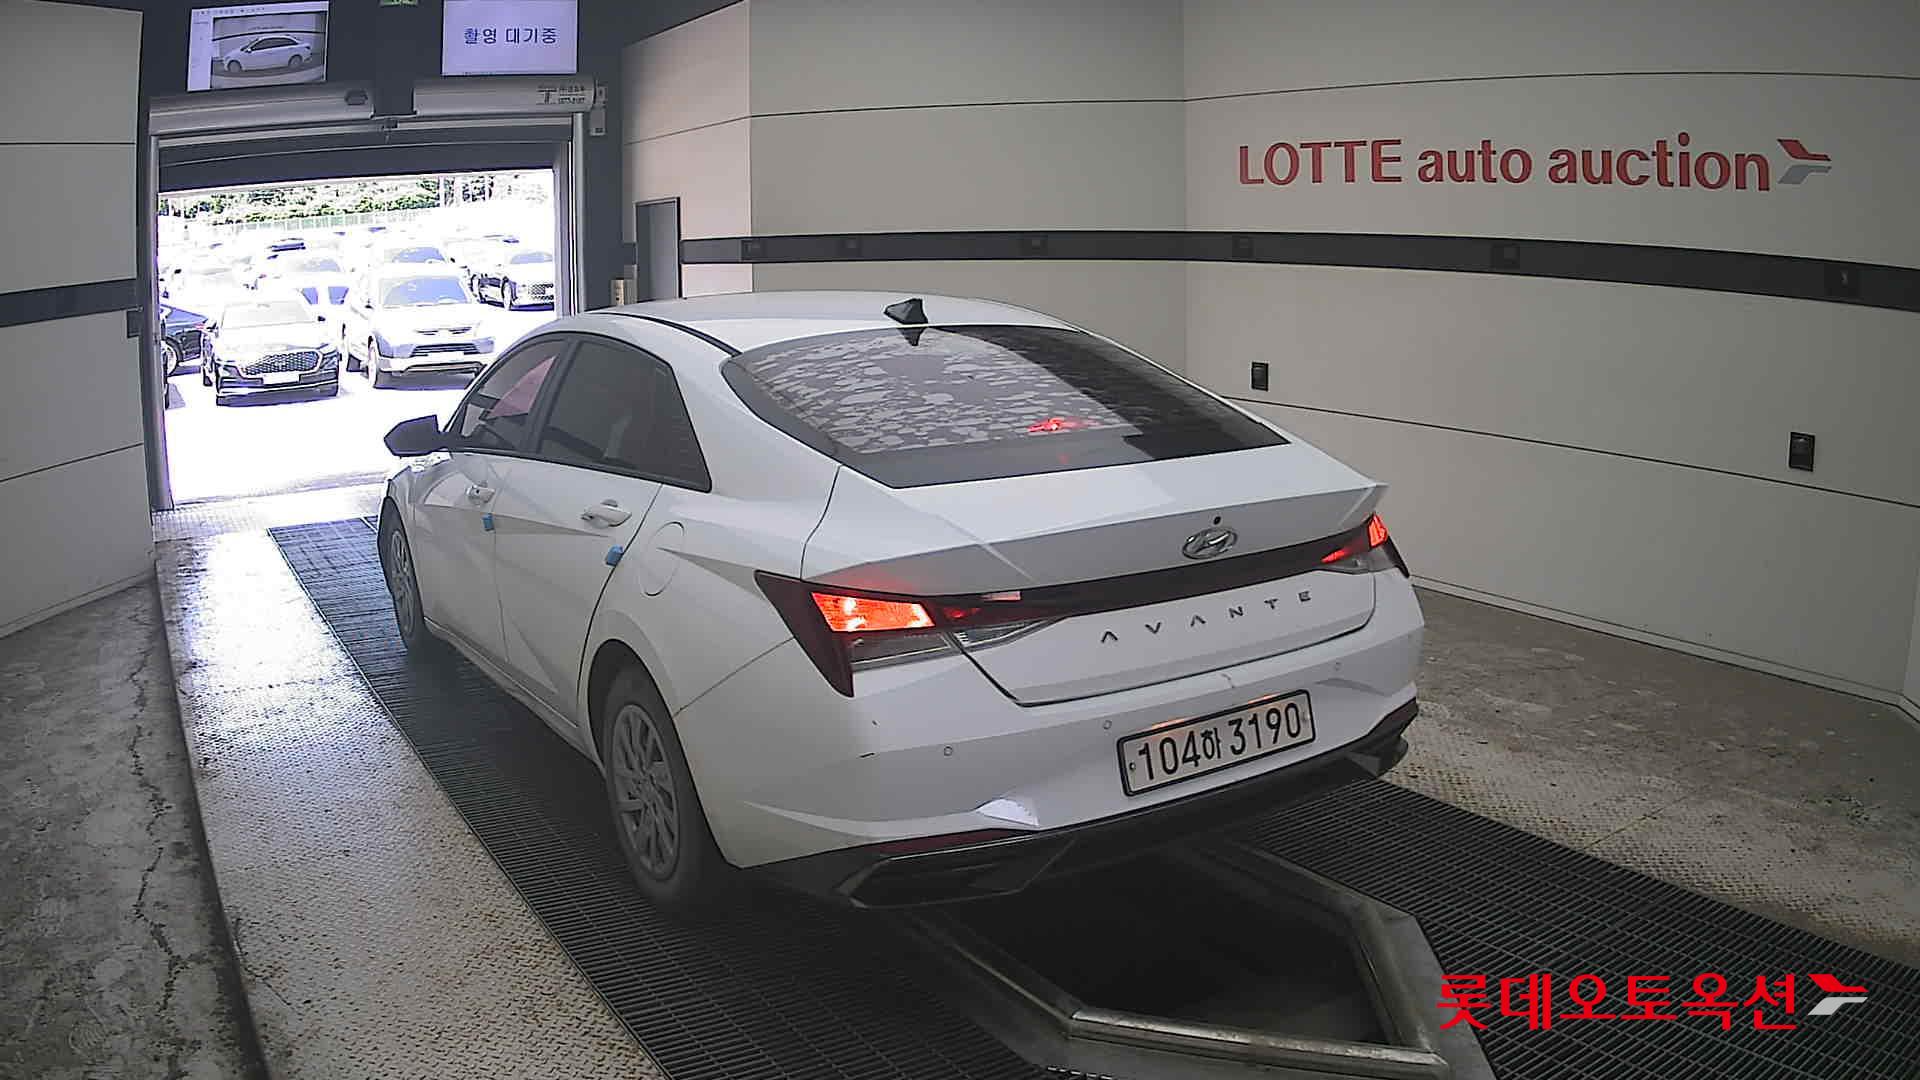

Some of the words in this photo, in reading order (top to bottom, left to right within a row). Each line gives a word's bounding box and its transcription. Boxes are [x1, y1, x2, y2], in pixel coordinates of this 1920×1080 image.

[464, 27, 497, 45] 촬영
[505, 27, 558, 45] 대기중
[1239, 138, 1403, 185] LOTTE
[1417, 139, 1533, 185] auto
[1548, 132, 1771, 192] auction
[1101, 590, 1312, 643] AVANTE
[1138, 727, 1222, 780] 104하
[1228, 702, 1301, 755] 3190
